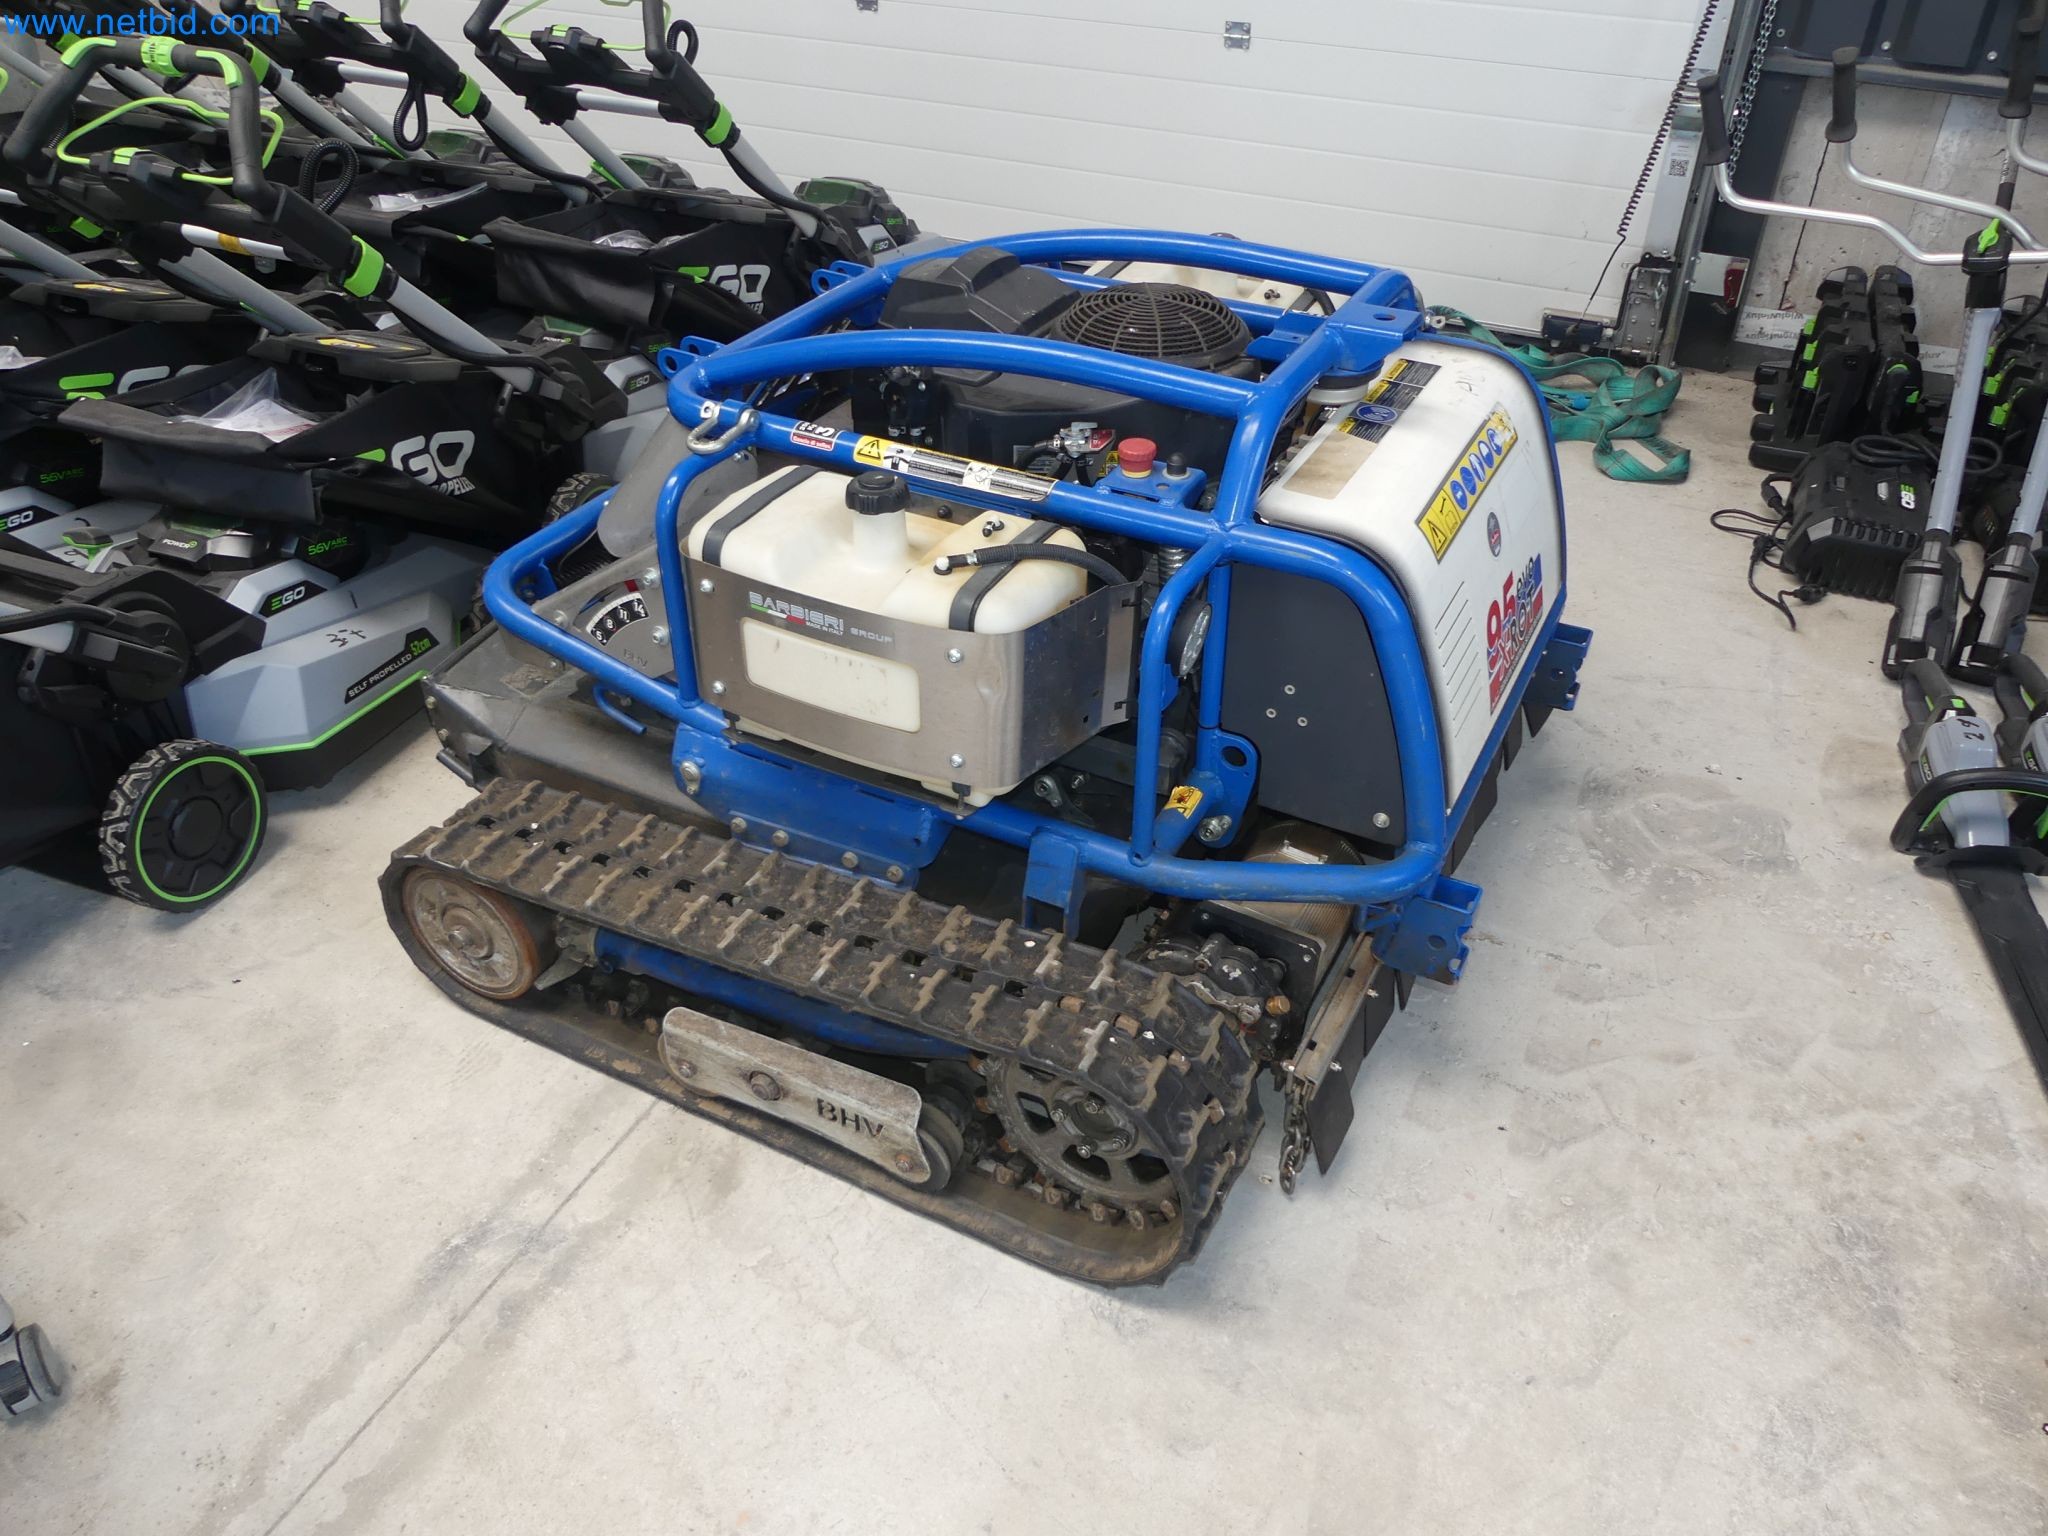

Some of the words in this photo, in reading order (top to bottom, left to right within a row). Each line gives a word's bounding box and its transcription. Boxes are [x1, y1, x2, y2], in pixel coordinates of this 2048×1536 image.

[678, 264, 771, 303] GO
[353, 429, 476, 486] GO
[1900, 484, 1915, 509] EGO
[271, 586, 305, 611] EGO
[749, 591, 844, 631] BARBIERI
[850, 626, 894, 643] GROUP
[806, 621, 821, 630] MADE
[348, 680, 368, 698] SELF
[368, 653, 414, 684] PROPELLED
[410, 638, 432, 656] 52cm
[817, 1098, 884, 1137] BHV
